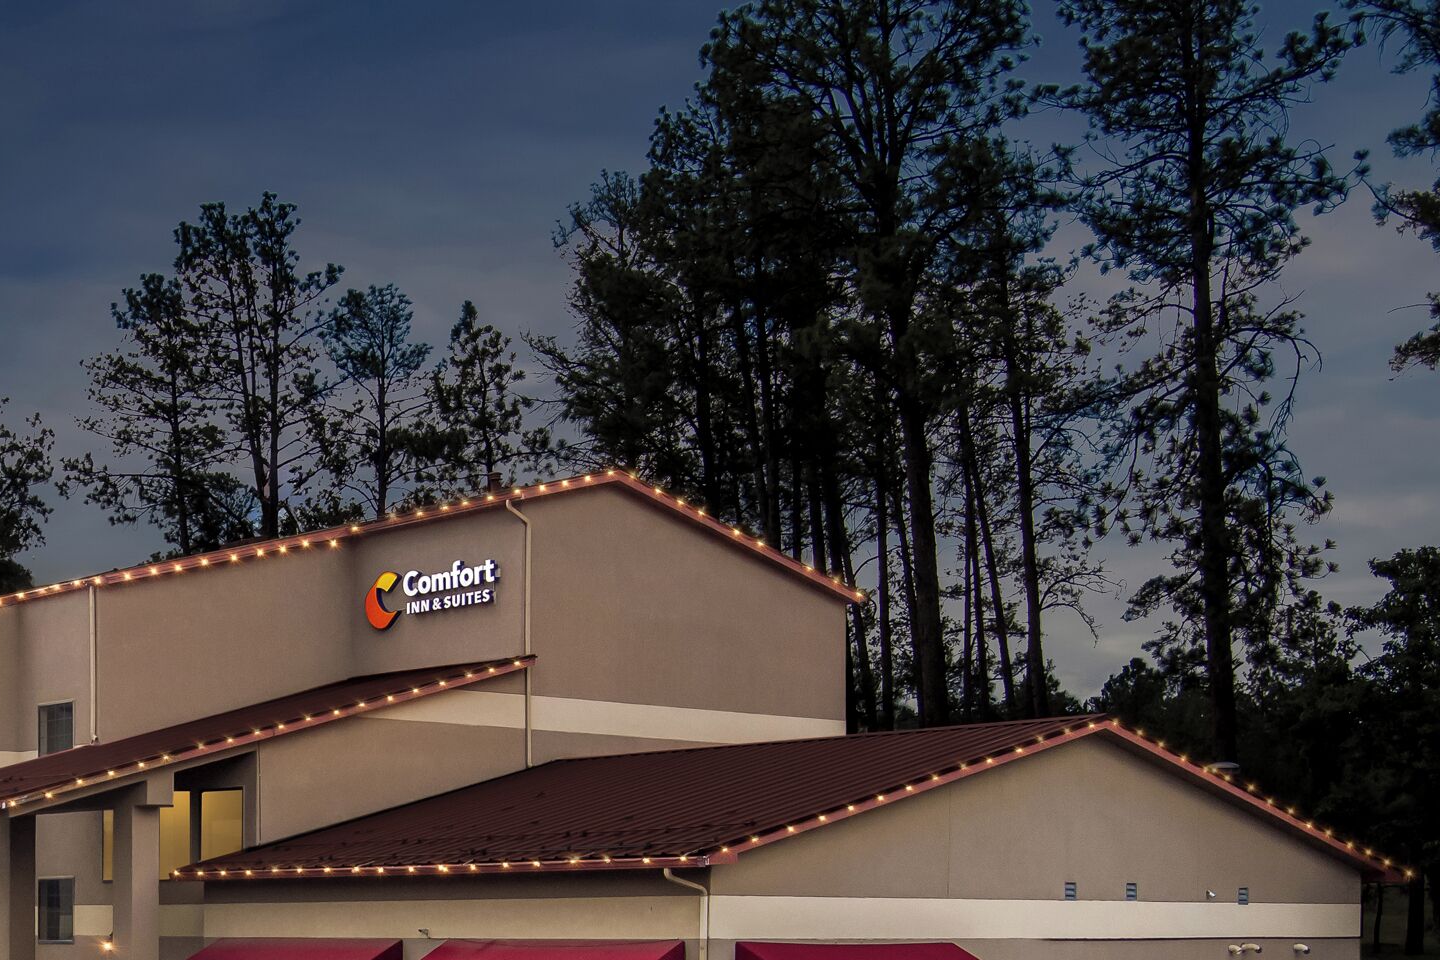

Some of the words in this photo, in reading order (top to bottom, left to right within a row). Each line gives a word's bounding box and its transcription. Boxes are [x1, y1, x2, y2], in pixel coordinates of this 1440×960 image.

[403, 559, 495, 597] Comfort
[406, 599, 430, 615] INN
[432, 597, 442, 611] &
[444, 588, 490, 609] SUITES
